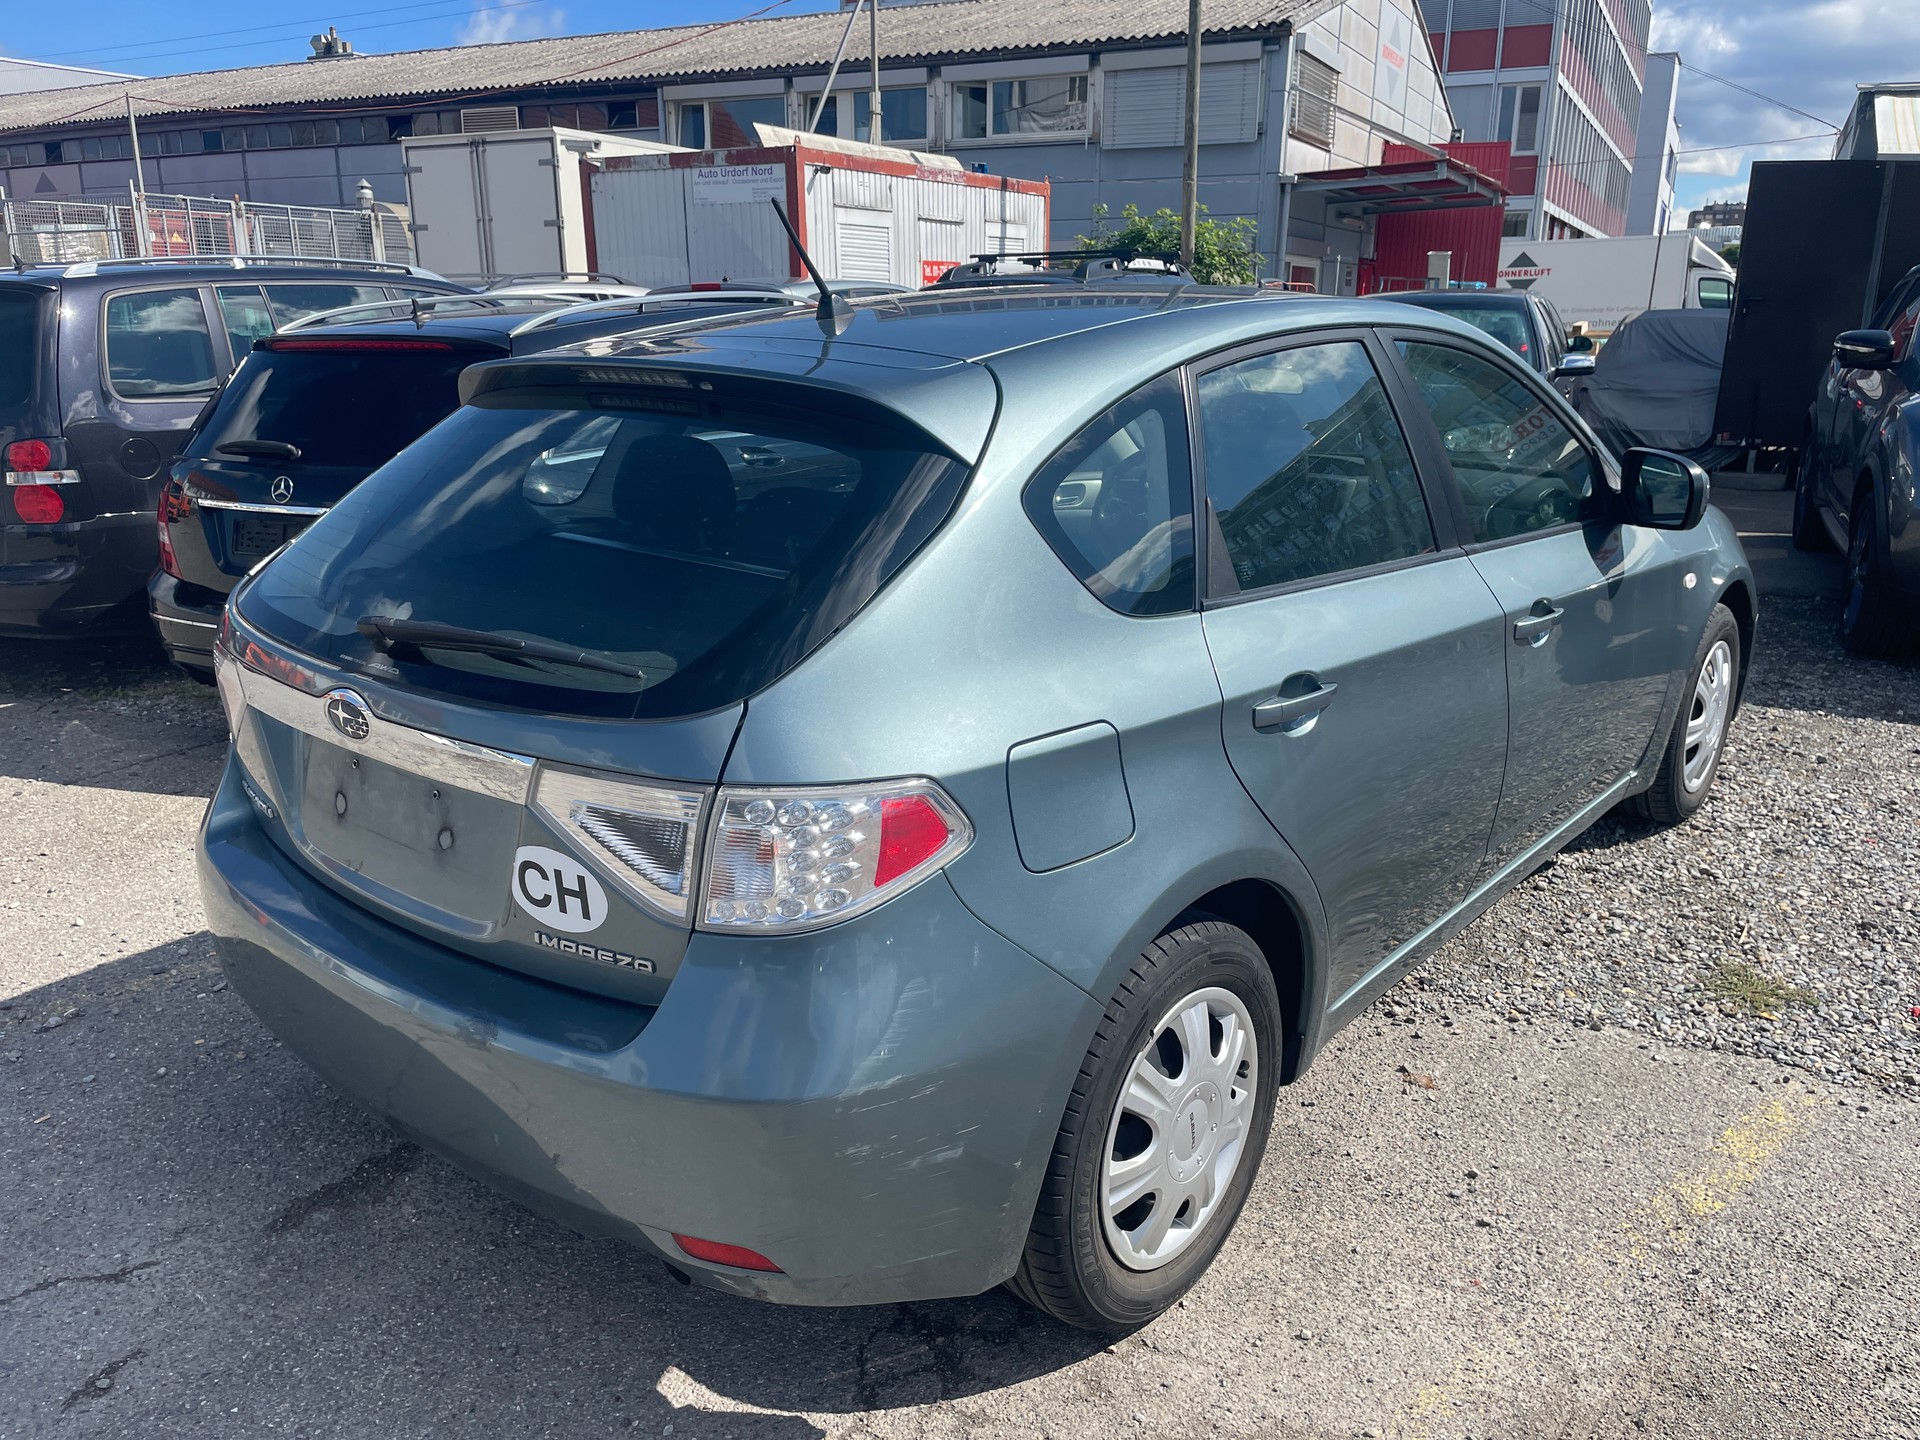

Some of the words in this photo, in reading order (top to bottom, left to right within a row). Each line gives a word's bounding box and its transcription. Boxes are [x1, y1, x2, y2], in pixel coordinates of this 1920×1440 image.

[698, 169, 718, 178] Auto
[721, 167, 749, 177] Urdorf
[751, 166, 773, 176] Nord
[1497, 268, 1552, 278] OHNERLUFT
[367, 662, 400, 675] AWD
[518, 860, 592, 921] CH
[533, 930, 657, 974] IMPREZA
